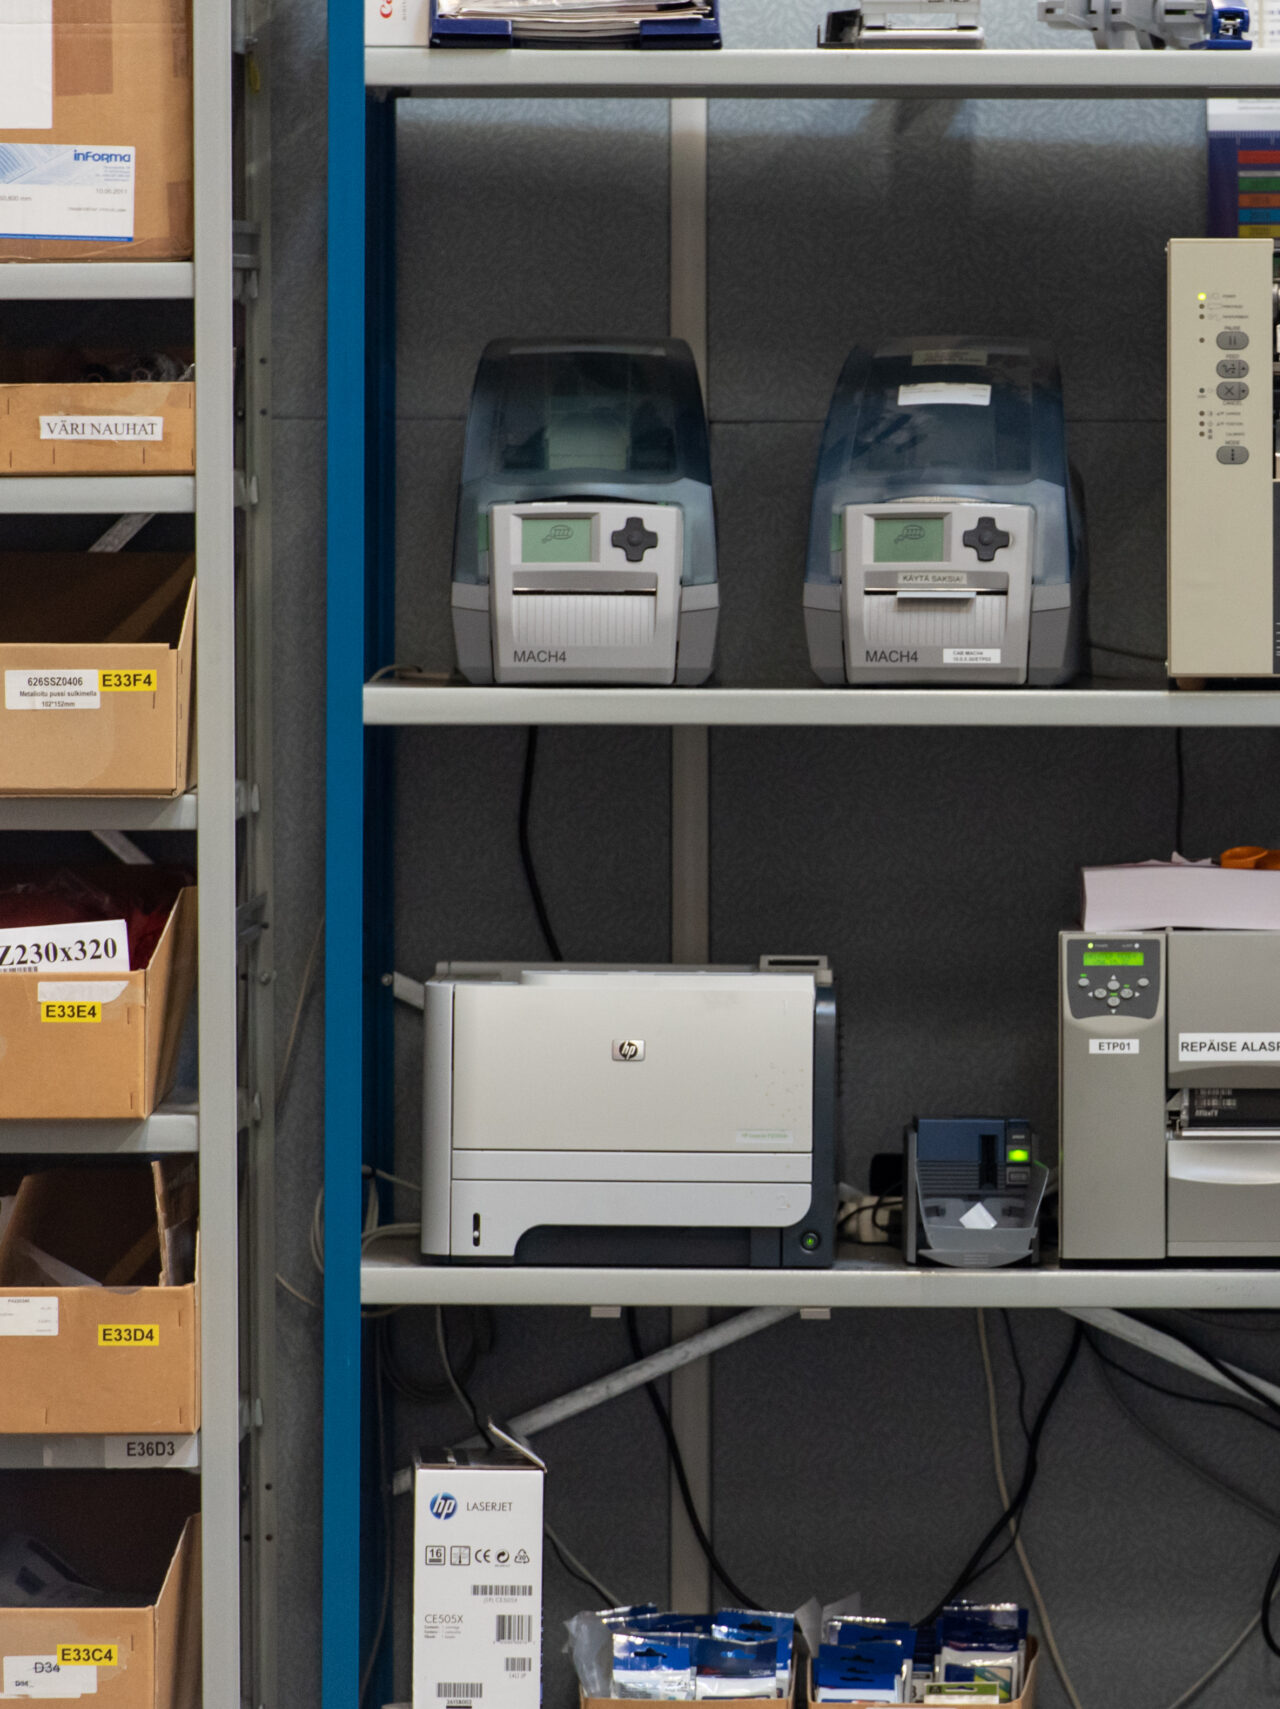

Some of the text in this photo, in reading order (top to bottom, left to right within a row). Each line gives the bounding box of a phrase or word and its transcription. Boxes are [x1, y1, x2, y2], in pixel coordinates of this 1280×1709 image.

[73, 149, 131, 163] informa
[47, 420, 157, 435] VÄRI NAUHAT
[514, 651, 566, 663] MACH4
[866, 651, 918, 663] MACH4
[28, 677, 83, 686] 626SSZ0406
[102, 674, 152, 687] E33F4
[46, 1005, 96, 1018] E33E4
[1099, 1042, 1131, 1051] ETP01
[1181, 1039, 1237, 1052] REPÄISE
[102, 1328, 154, 1341] E33D4
[127, 1442, 174, 1456] E36D3
[430, 1492, 512, 1520] hp LASERJET
[429, 1549, 442, 1558] 16
[425, 1614, 463, 1624] CE505X
[62, 1649, 113, 1661] E33C4
